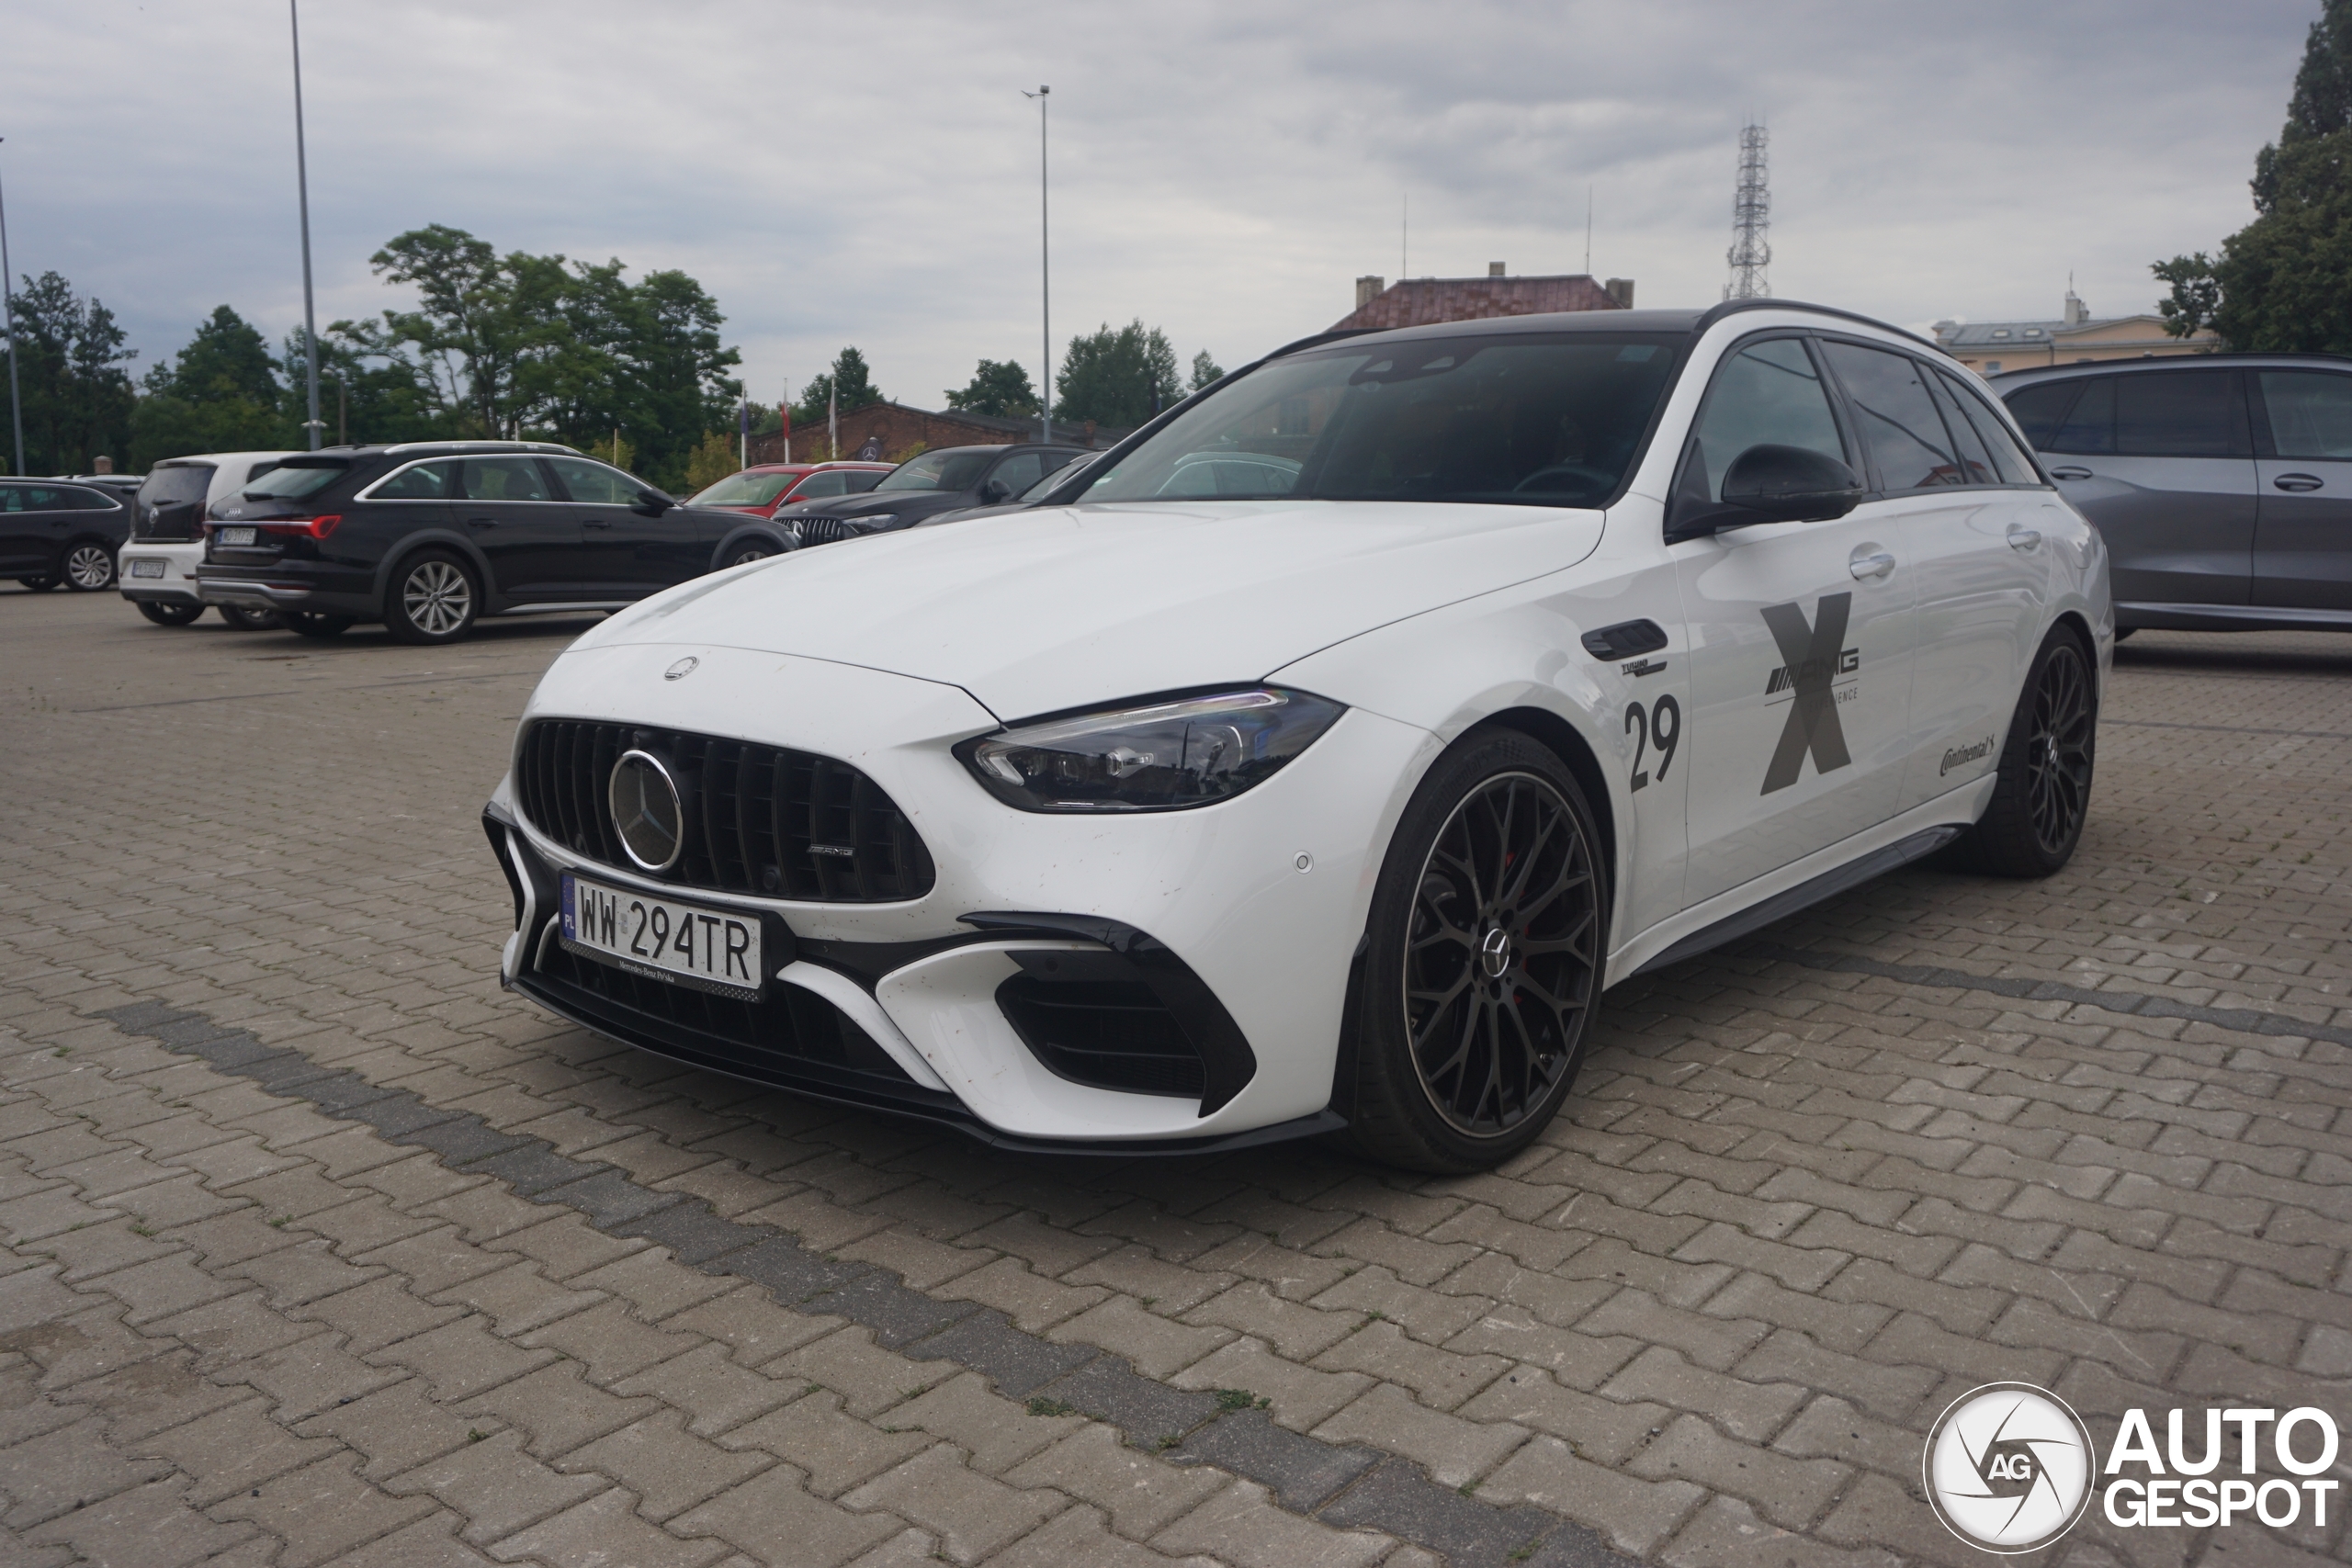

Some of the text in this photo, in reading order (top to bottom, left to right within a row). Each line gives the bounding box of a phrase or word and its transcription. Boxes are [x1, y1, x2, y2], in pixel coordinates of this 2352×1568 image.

[1624, 694, 1680, 794] 29
[1940, 737, 1989, 777] Continental
[564, 914, 574, 930] PL
[581, 885, 750, 981] WW 294TR
[619, 960, 656, 977] Mercedes-Benz
